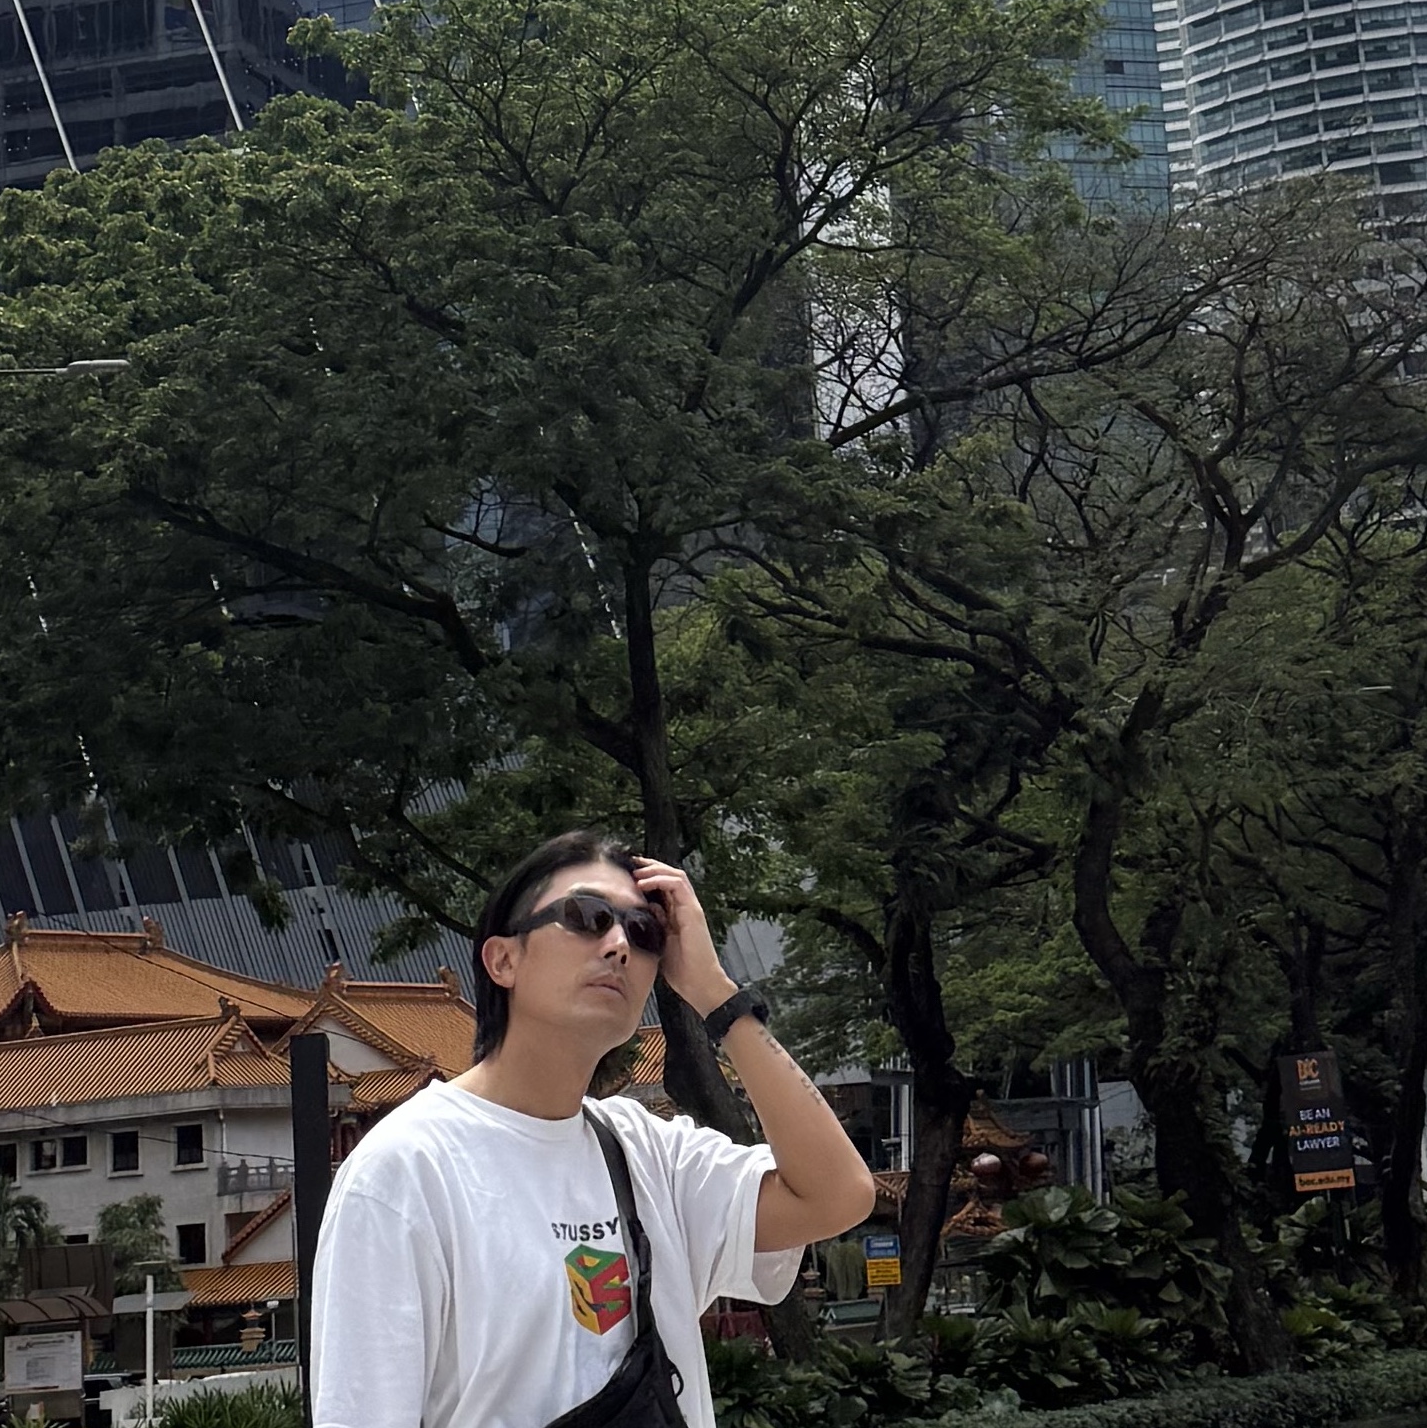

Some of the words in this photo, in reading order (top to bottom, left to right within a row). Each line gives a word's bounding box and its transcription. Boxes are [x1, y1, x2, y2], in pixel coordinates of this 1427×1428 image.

[1299, 1109, 1314, 1121] BE
[1315, 1107, 1331, 1119] AN
[1296, 1136, 1340, 1151] LAWYER
